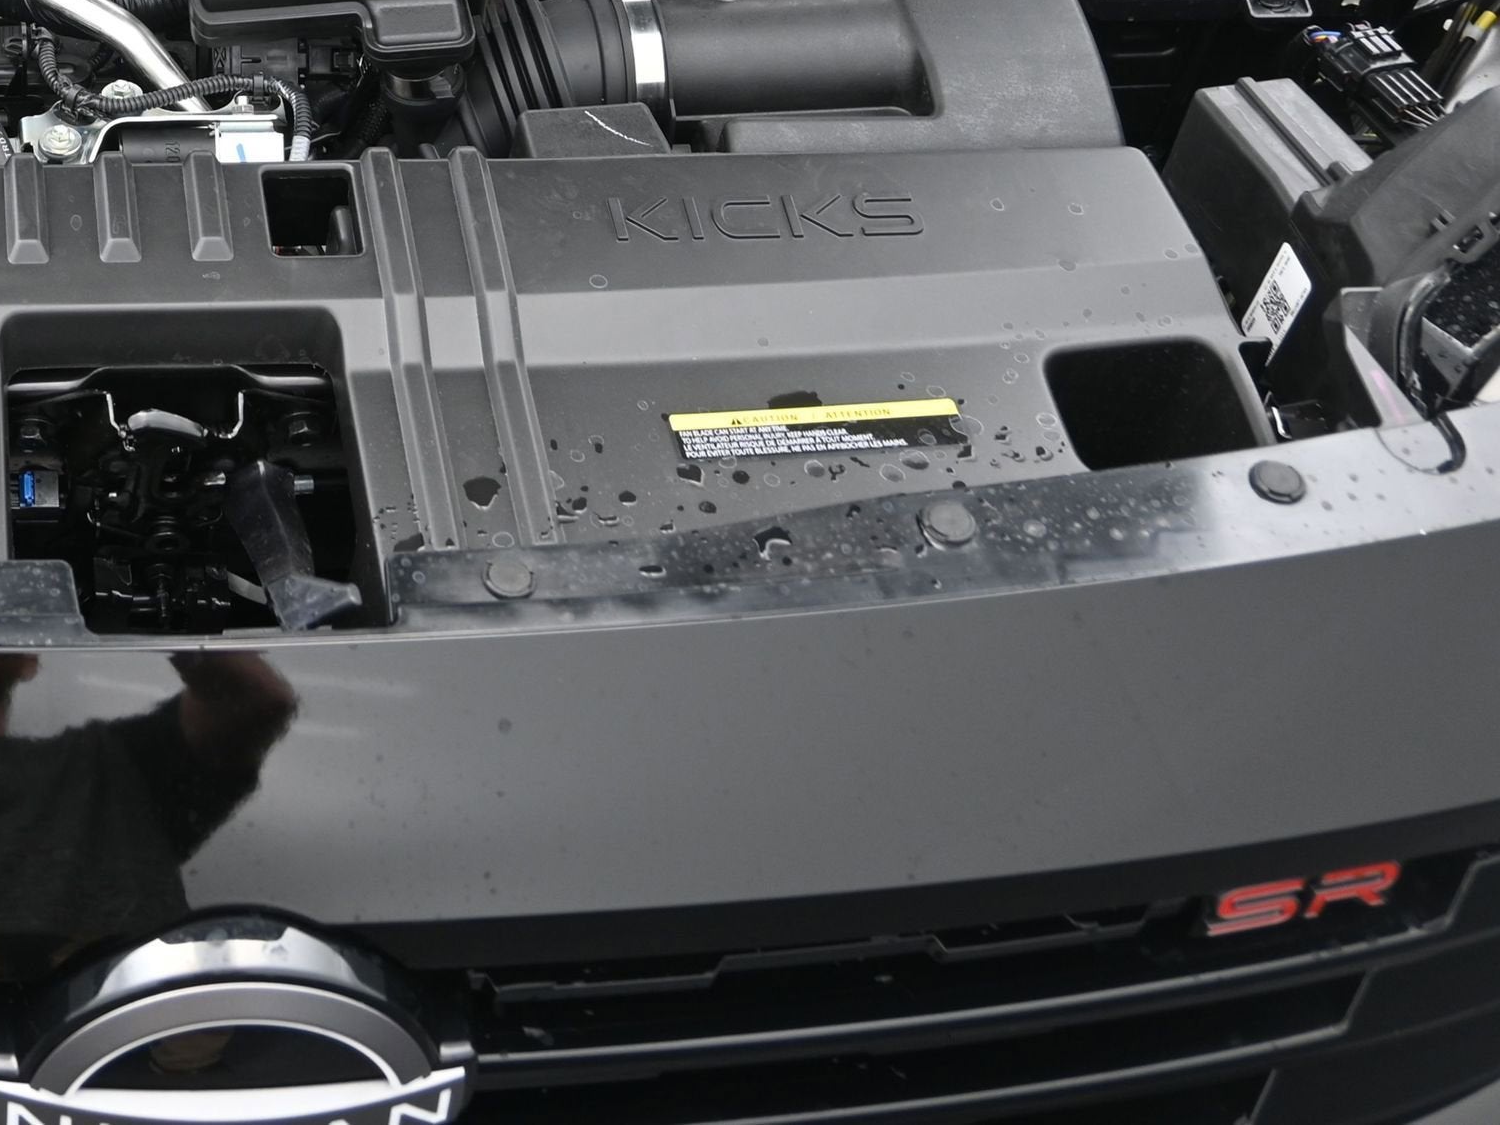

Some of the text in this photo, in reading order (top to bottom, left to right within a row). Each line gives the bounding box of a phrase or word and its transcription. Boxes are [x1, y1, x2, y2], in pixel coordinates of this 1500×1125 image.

[606, 194, 925, 242] KICKS
[743, 415, 799, 424] CAUTION
[826, 409, 891, 419] ATTENTION
[714, 428, 729, 436] CAN
[729, 427, 748, 435] START
[681, 437, 692, 445] TO
[692, 436, 709, 445] HELP
[683, 444, 693, 452] LE
[821, 435, 841, 444] TOUT
[1205, 859, 1402, 938] SR
